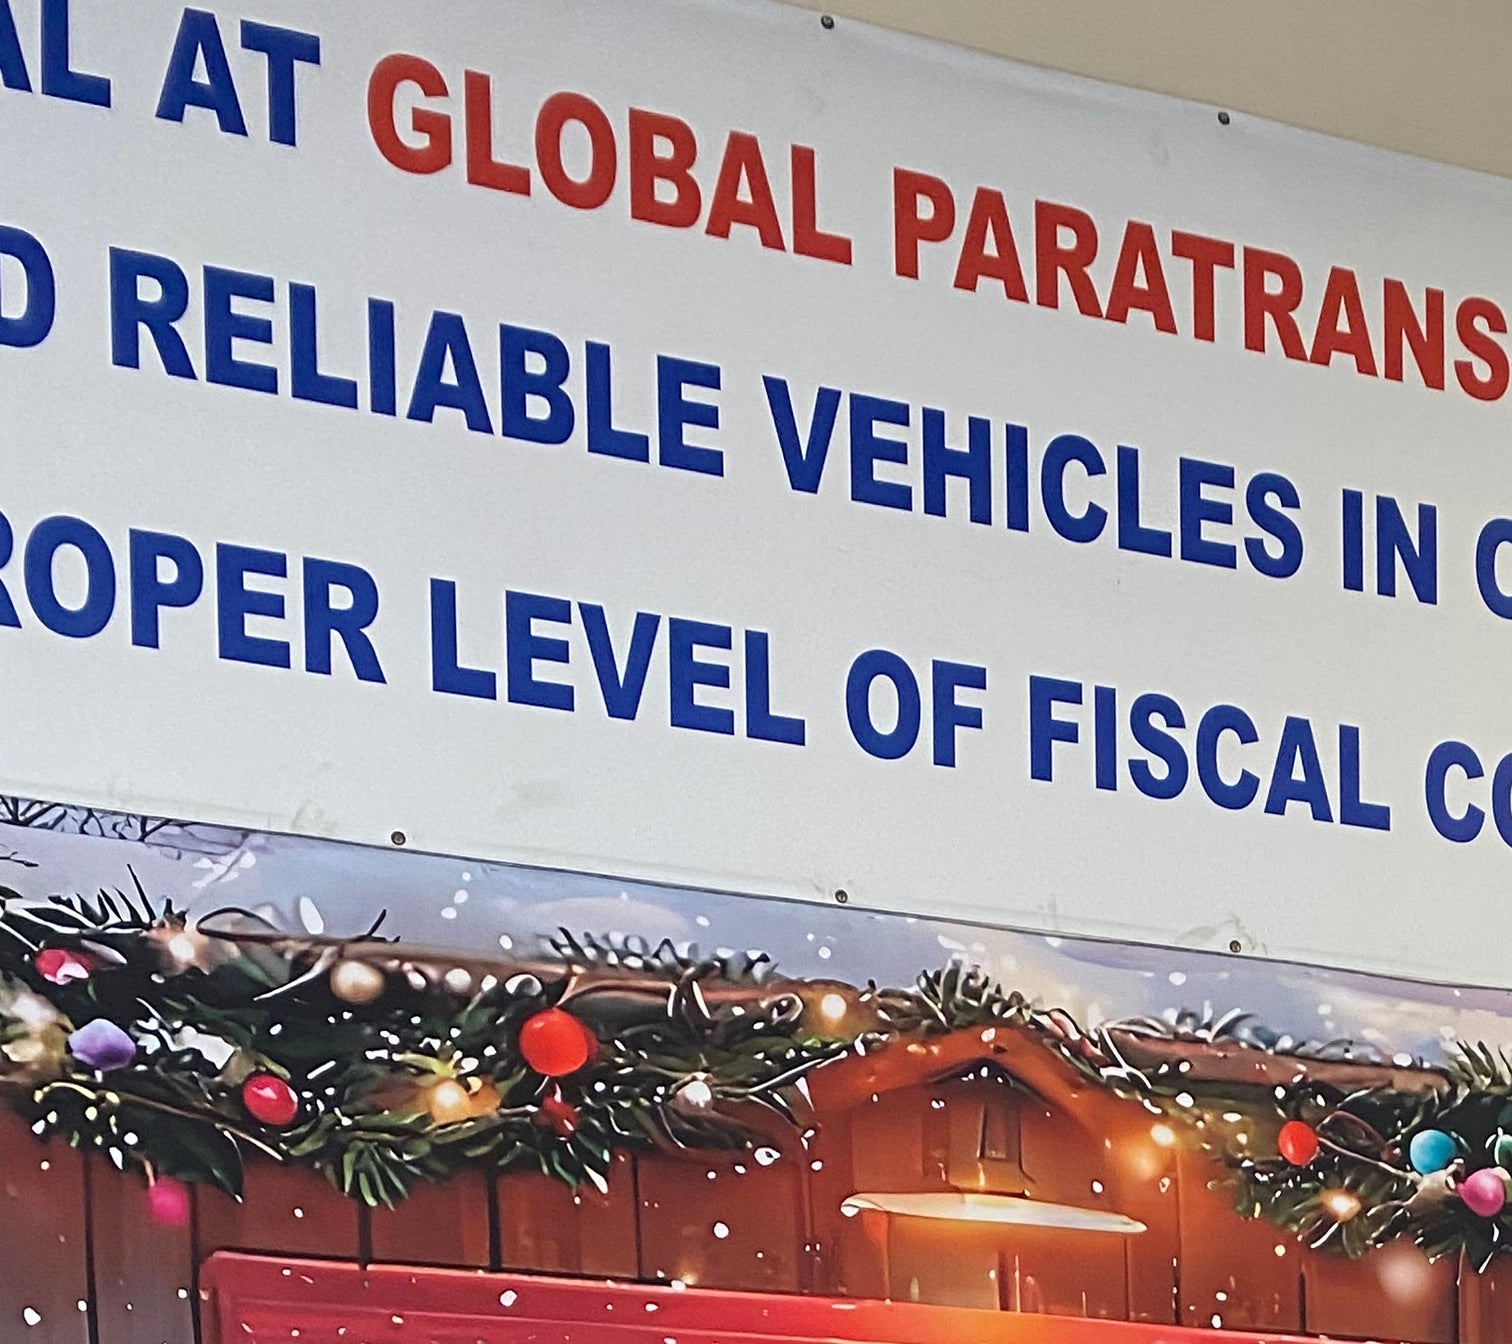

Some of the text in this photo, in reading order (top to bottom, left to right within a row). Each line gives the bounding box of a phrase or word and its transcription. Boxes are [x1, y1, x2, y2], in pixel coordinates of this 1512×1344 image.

[156, 9, 320, 146] AT
[368, 55, 852, 265] GLOBAL
[110, 247, 724, 477] RELIABLE
[763, 376, 1304, 578] VEHICLES
[1342, 490, 1438, 604] IN
[0, 510, 387, 684] OPER
[431, 579, 805, 747] LEVEL
[846, 650, 987, 768] OF
[1029, 676, 1391, 831] FISCAL
